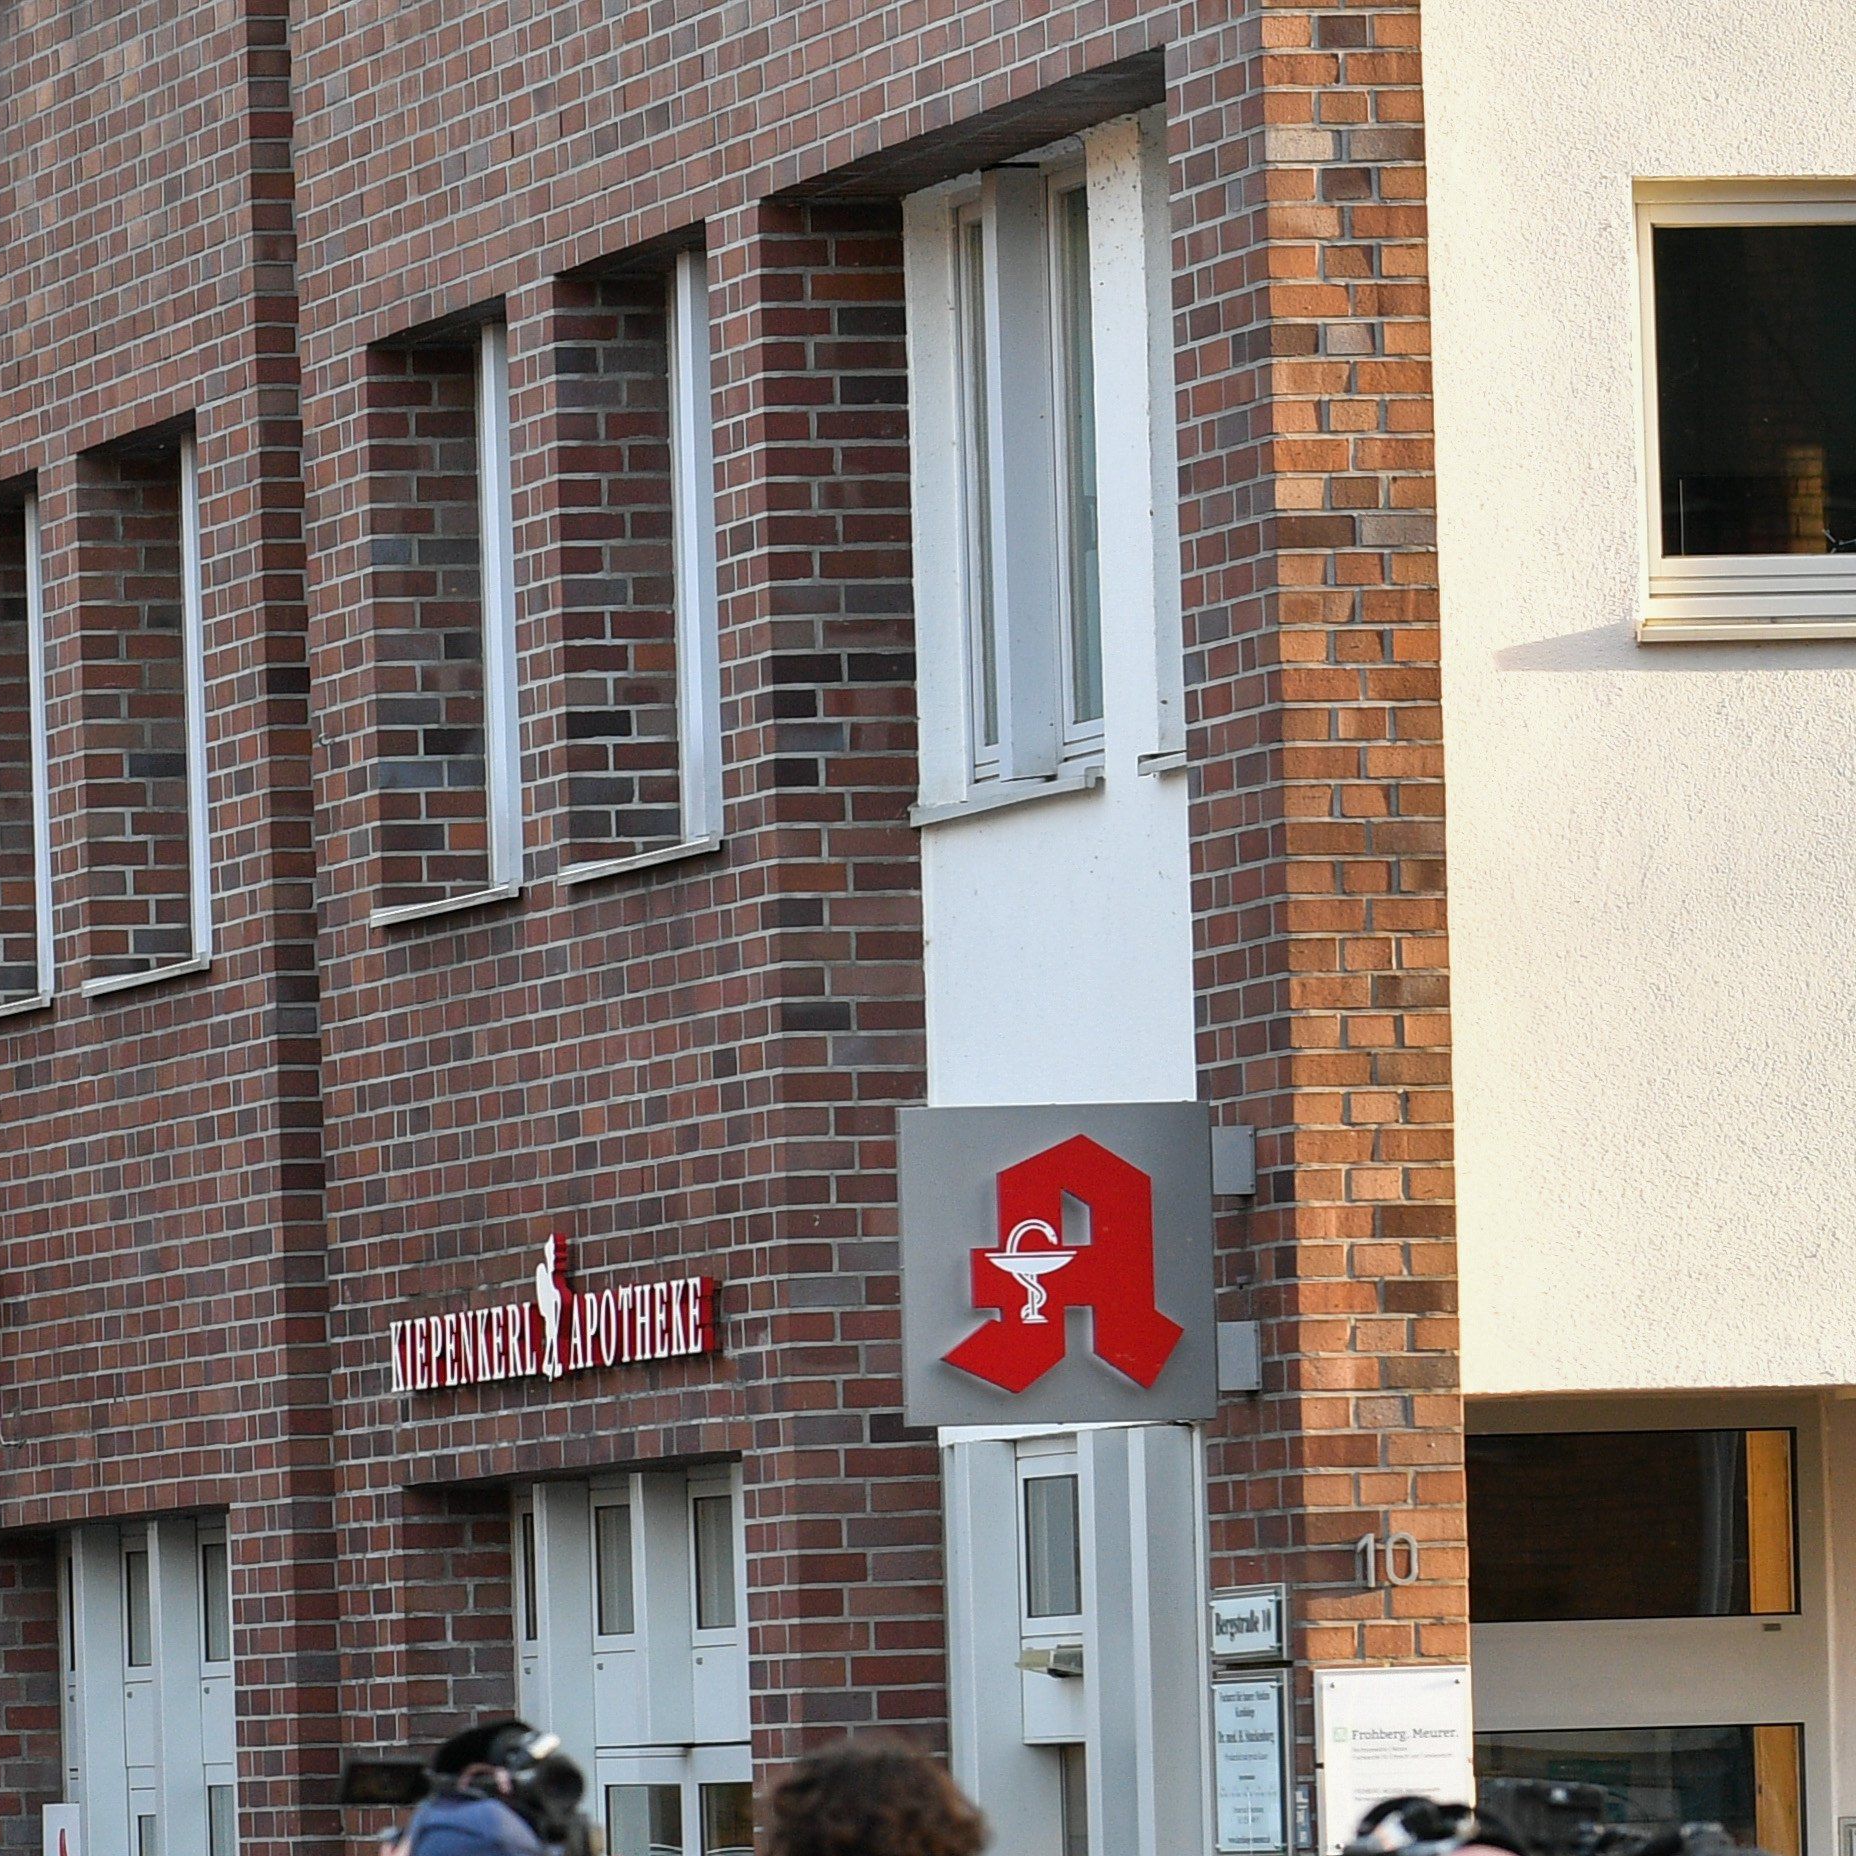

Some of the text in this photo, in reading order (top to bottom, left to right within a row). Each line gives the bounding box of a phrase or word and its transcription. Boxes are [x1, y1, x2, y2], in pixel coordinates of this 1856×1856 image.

[389, 1275, 703, 1393] KIEPENKERL APOTHEKE
[1354, 1532, 1420, 1588] 10
[1412, 1727, 1459, 1740] Meurer.
